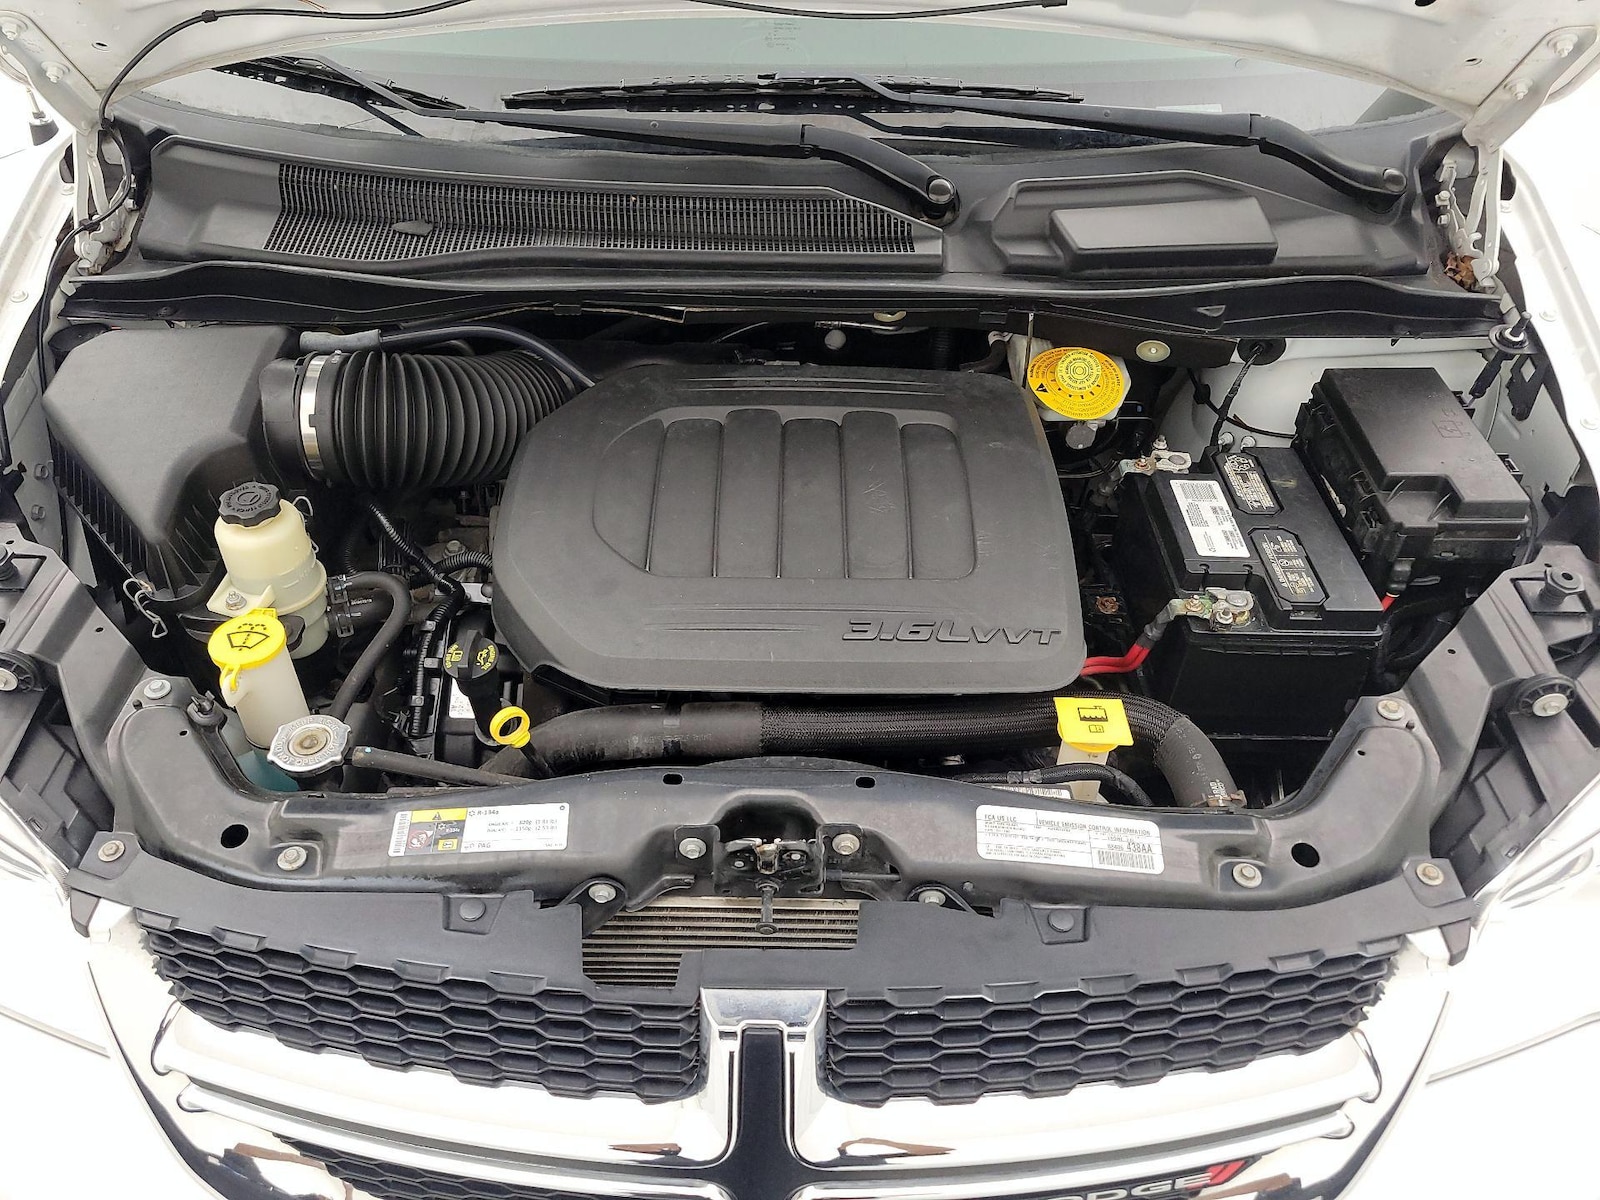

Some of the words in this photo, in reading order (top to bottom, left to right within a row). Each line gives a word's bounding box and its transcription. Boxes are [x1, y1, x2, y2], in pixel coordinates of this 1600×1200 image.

[842, 620, 970, 642] 3.6L
[971, 626, 1062, 645] VVT
[1038, 819, 1061, 828] VEHICLE
[1061, 821, 1087, 830] EMISSION
[1088, 824, 1112, 833] CONTROL
[1113, 827, 1151, 836] INFORMATION
[1126, 841, 1153, 853] 438AA
